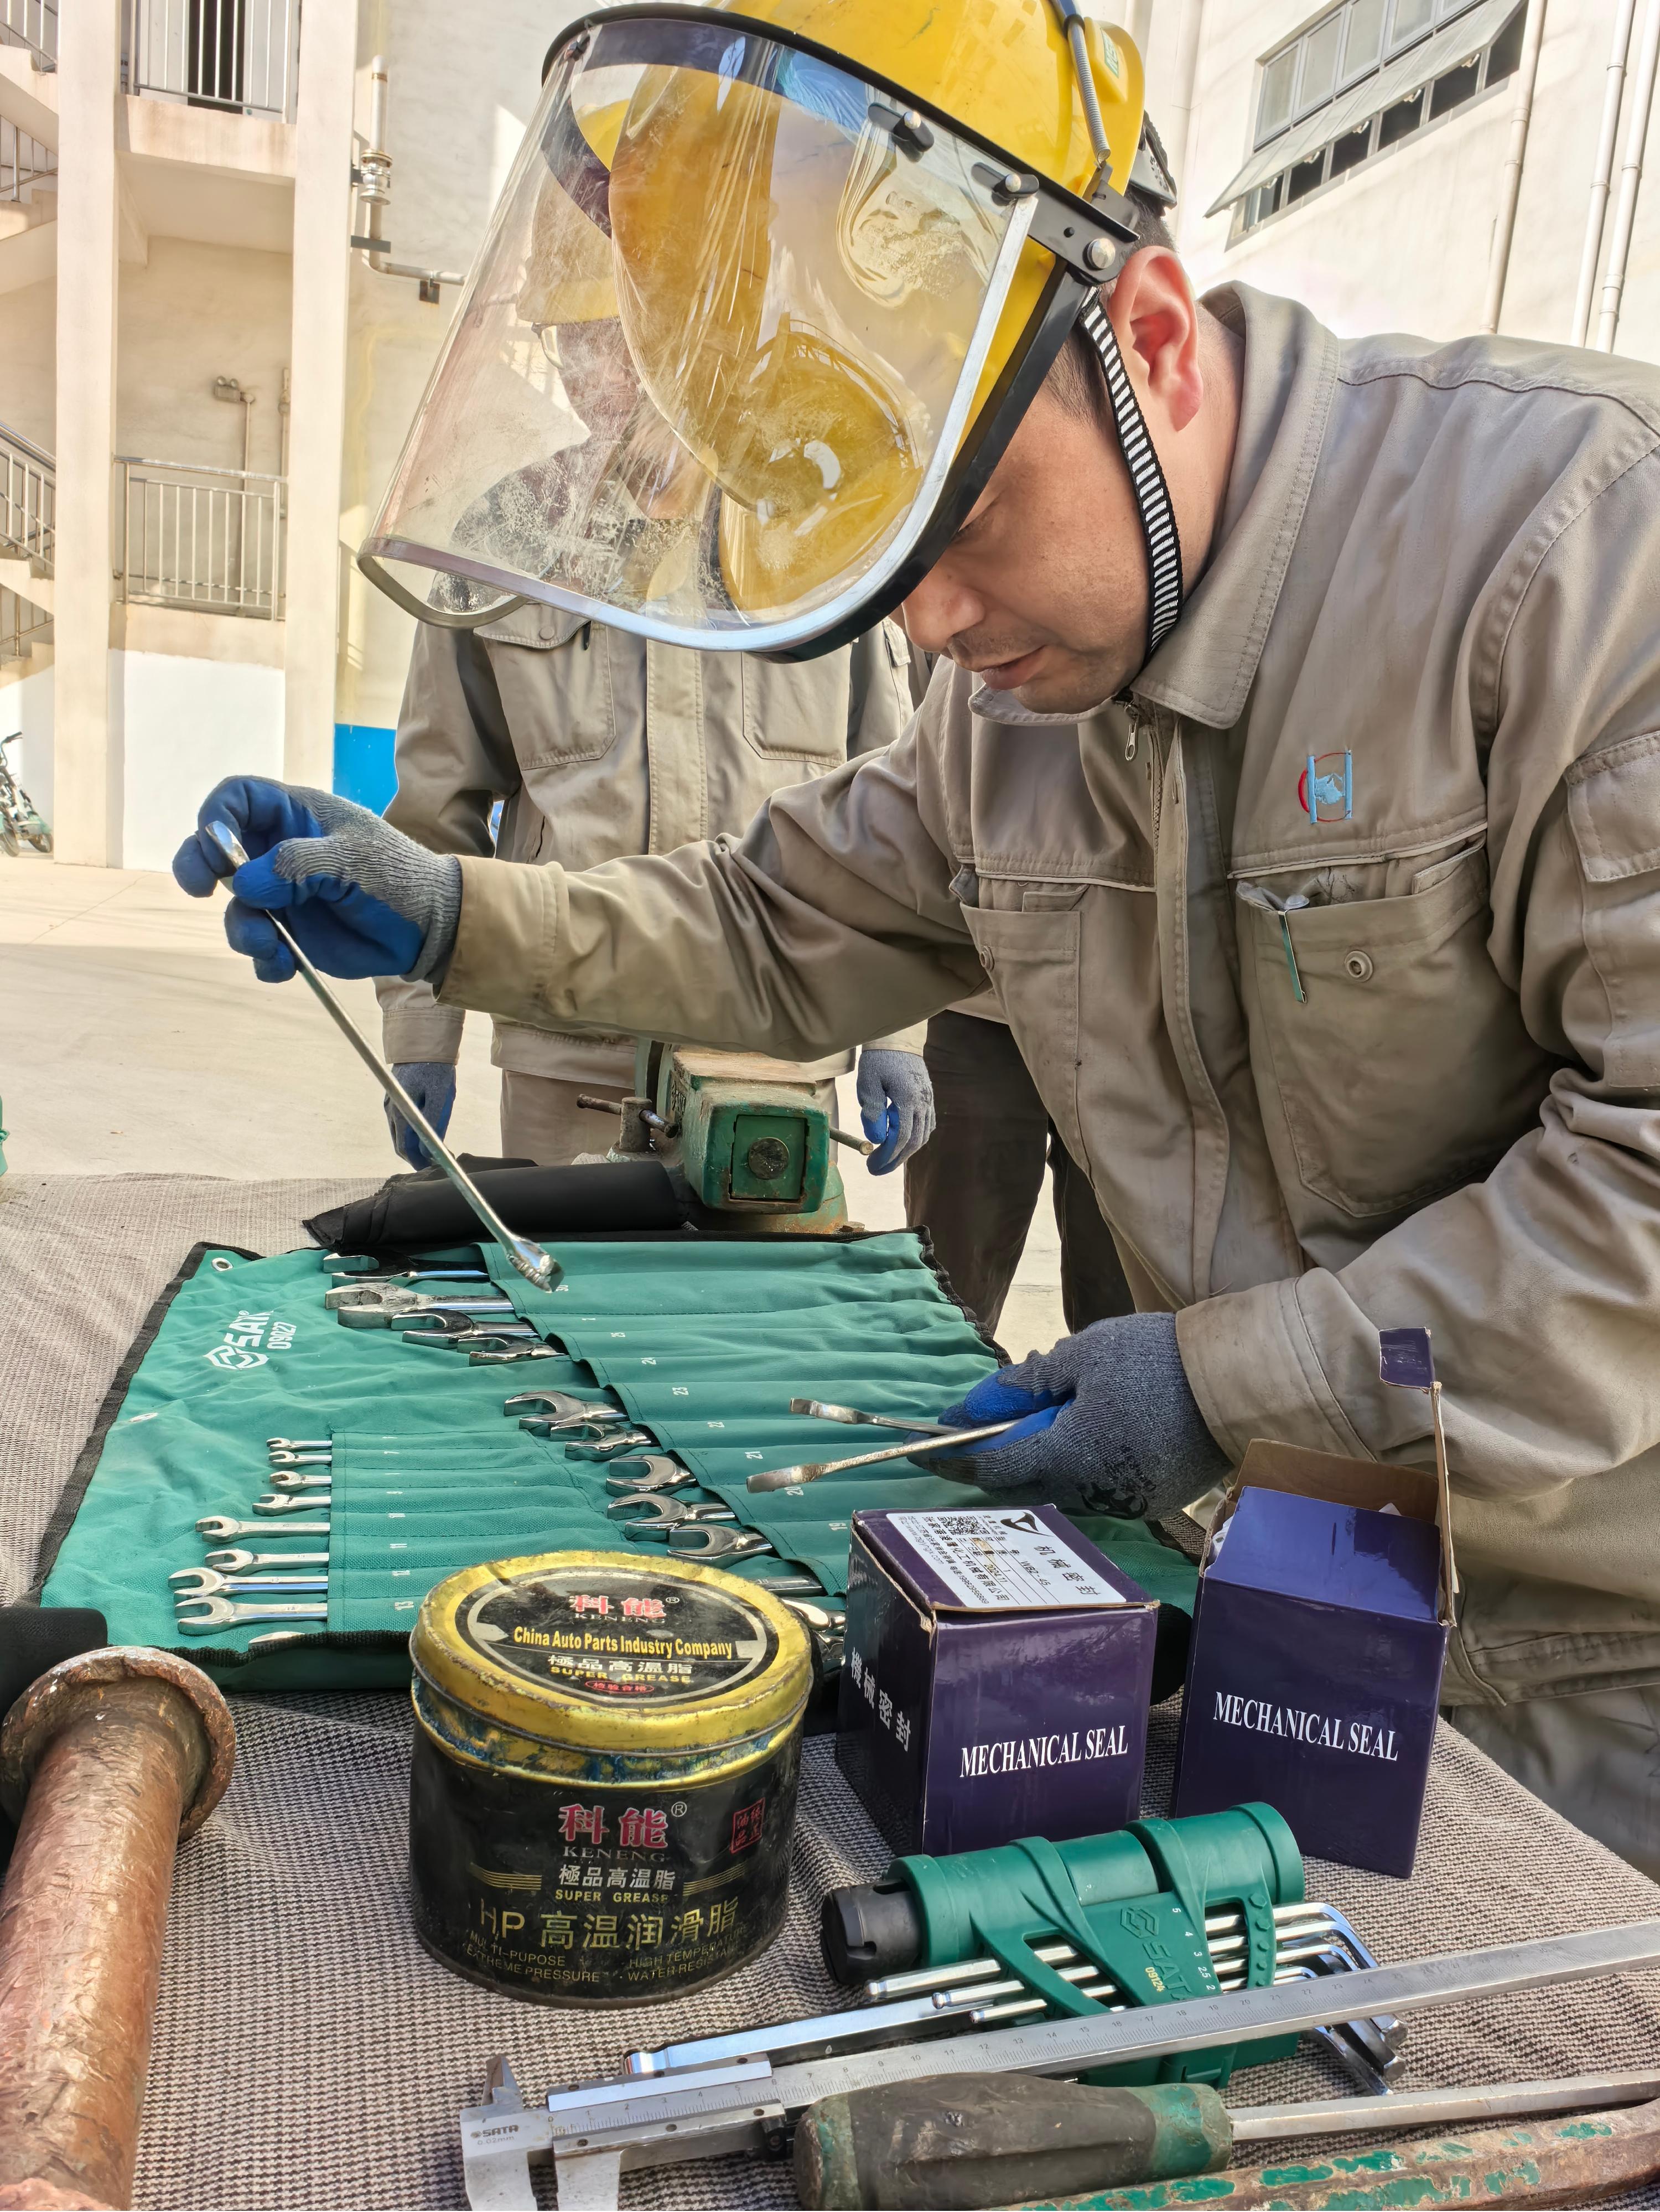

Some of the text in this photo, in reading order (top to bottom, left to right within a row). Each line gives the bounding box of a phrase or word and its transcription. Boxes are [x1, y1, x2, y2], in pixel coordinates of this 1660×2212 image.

[267, 1322, 297, 1349] 09027
[672, 1386, 689, 1396] 23
[745, 1451, 763, 1459] 21
[784, 1486, 803, 1496] 20
[828, 1522, 848, 1531] 19
[1034, 1545, 1100, 1595] 机械密封
[395, 1601, 414, 1611] 13
[569, 1594, 667, 1619] 科能
[574, 1613, 665, 1623] KENENG
[513, 1626, 732, 1659] China Auto Parts Industry Company
[551, 1666, 692, 1683] SUPER GREASE
[850, 1646, 912, 1753] 機械密封
[1213, 1691, 1399, 1762] MECHANICAL SEAL
[959, 1725, 1128, 1778] MECHANICAL SEAL
[558, 1803, 668, 1848] 科能
[563, 1846, 666, 1863] KENENG
[559, 1864, 676, 1890] 極品高温脂
[556, 1889, 668, 1903] SUPER GREASE
[480, 1896, 739, 1951] HP 高温润滑脂
[1145, 1966, 1165, 1992] 09124
[1198, 1966, 1211, 1978] 2.5
[483, 2124, 519, 2138] SATA
